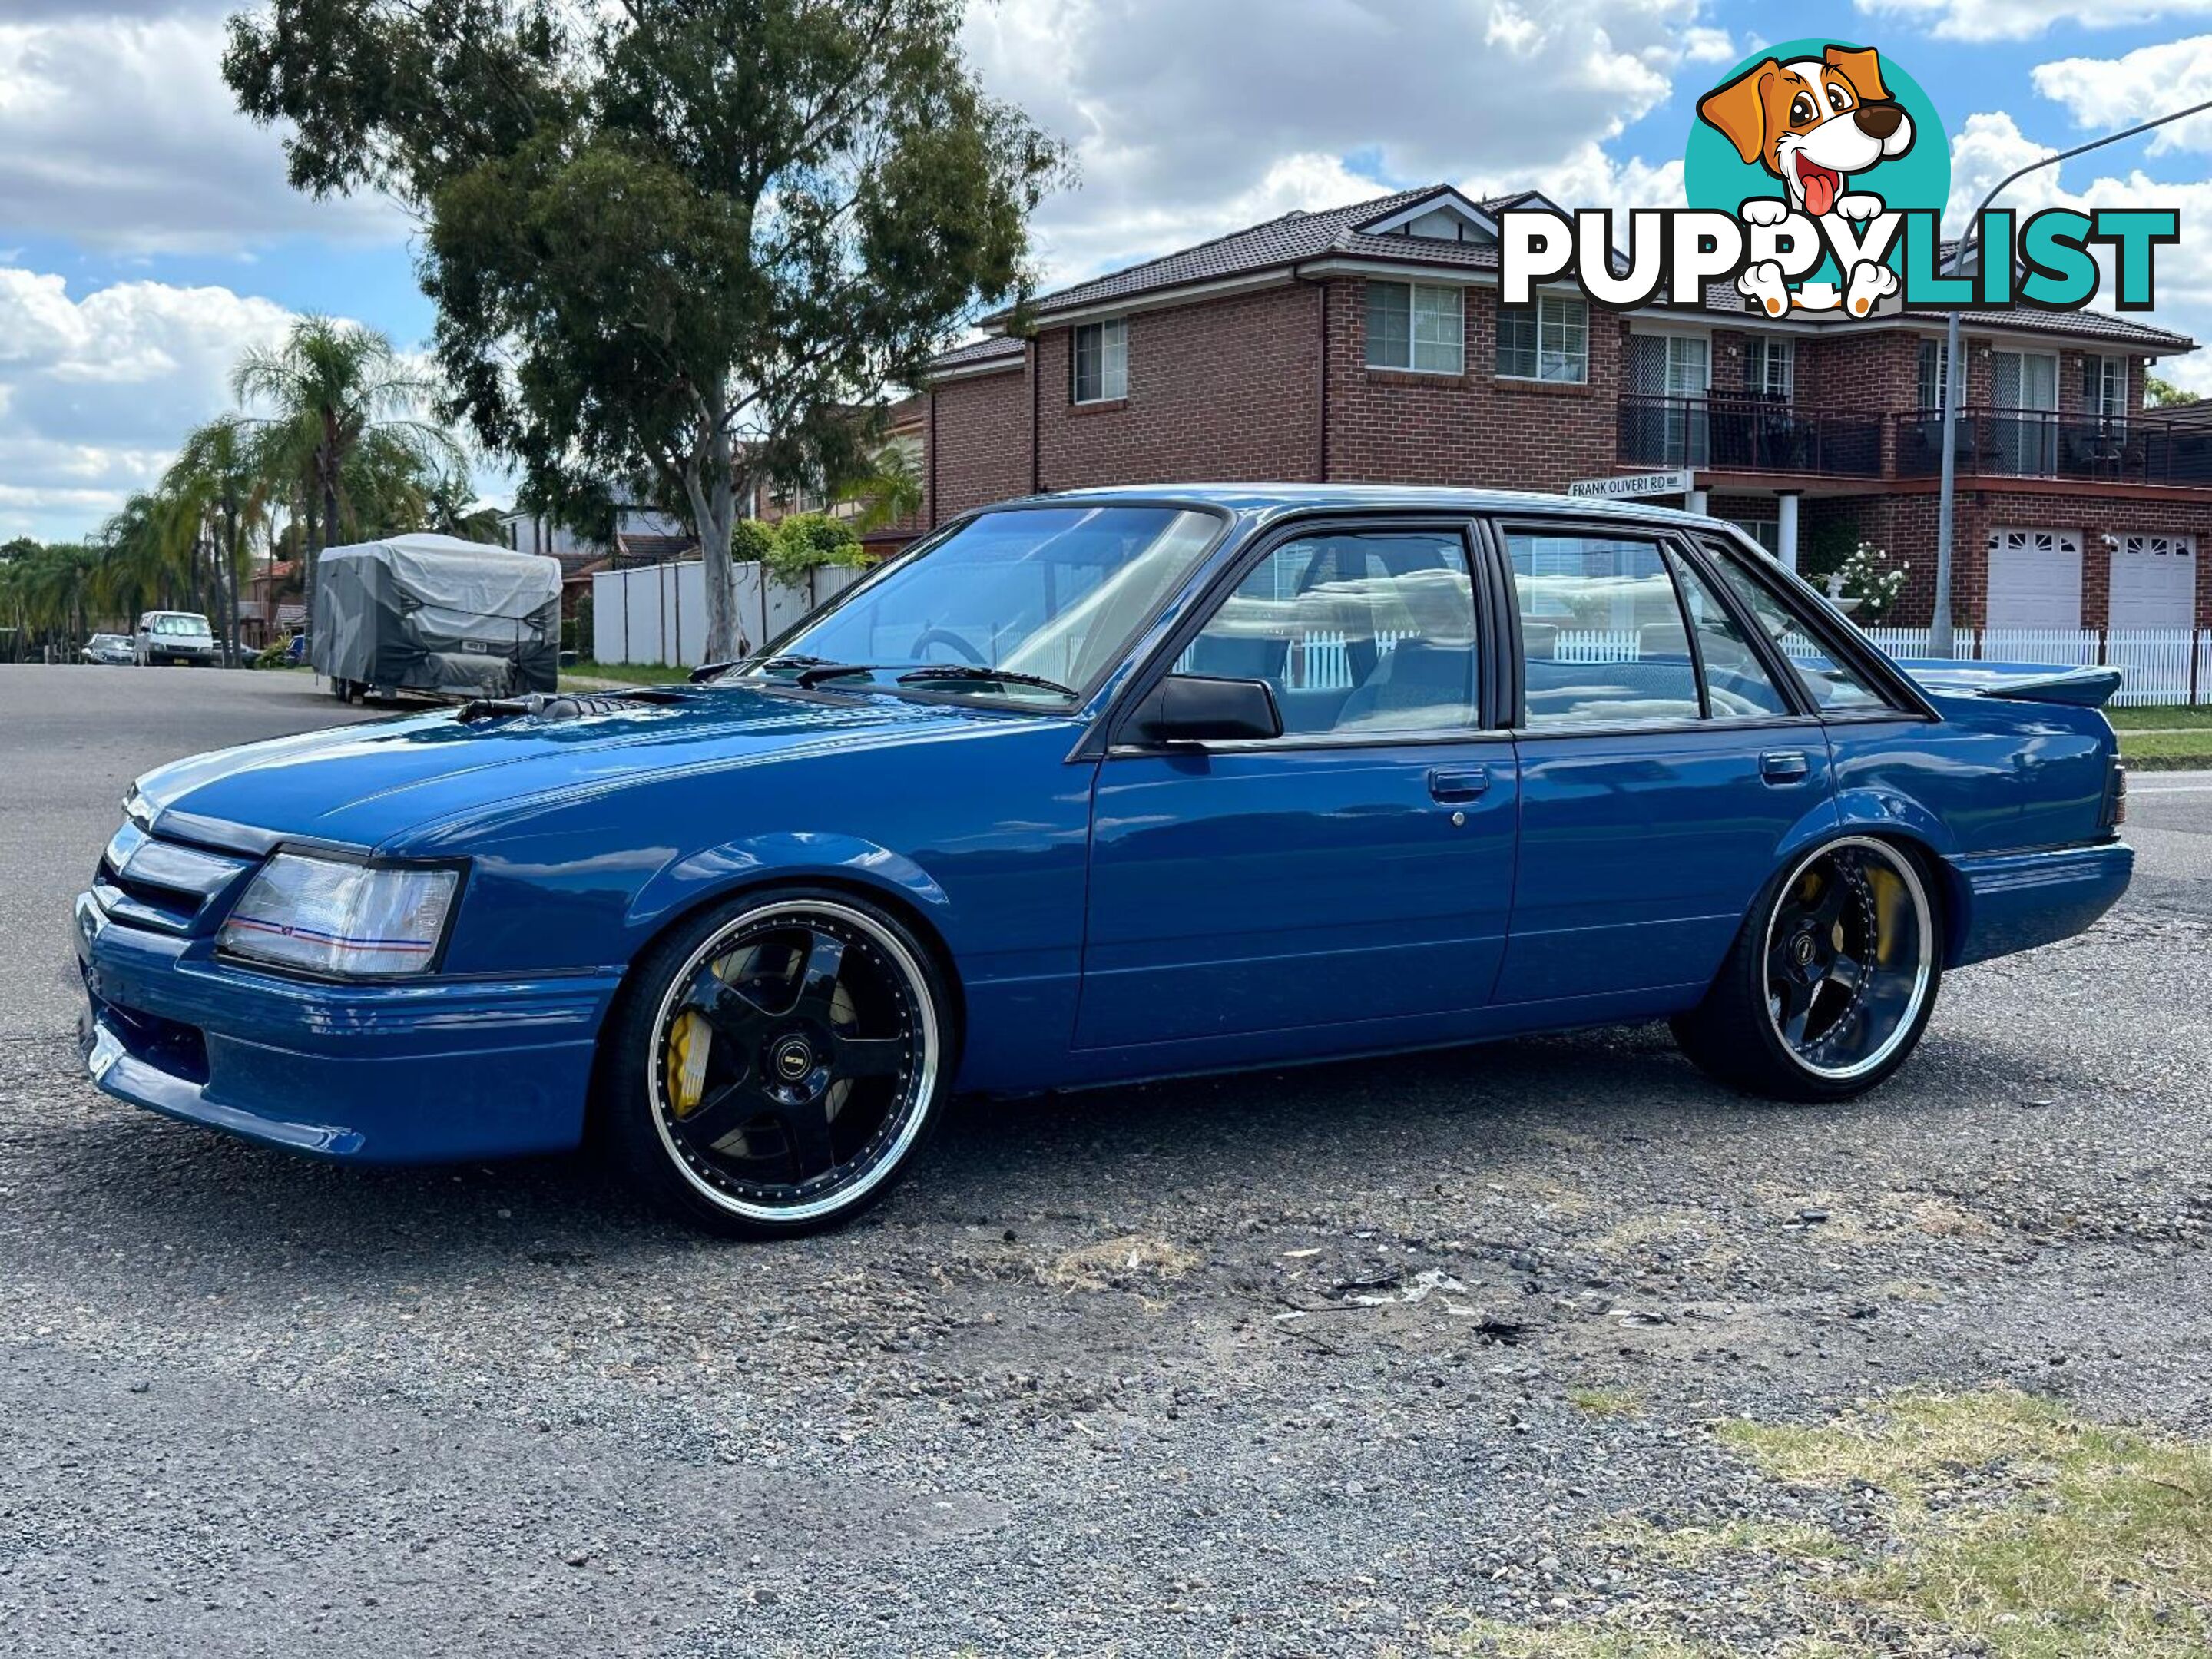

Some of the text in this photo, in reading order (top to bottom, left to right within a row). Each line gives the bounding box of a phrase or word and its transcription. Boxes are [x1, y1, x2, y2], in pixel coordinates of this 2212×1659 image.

[1573, 482, 1607, 497] FRANK
[1609, 477, 1647, 493] OLIVERI
[1651, 475, 1665, 489] RD
